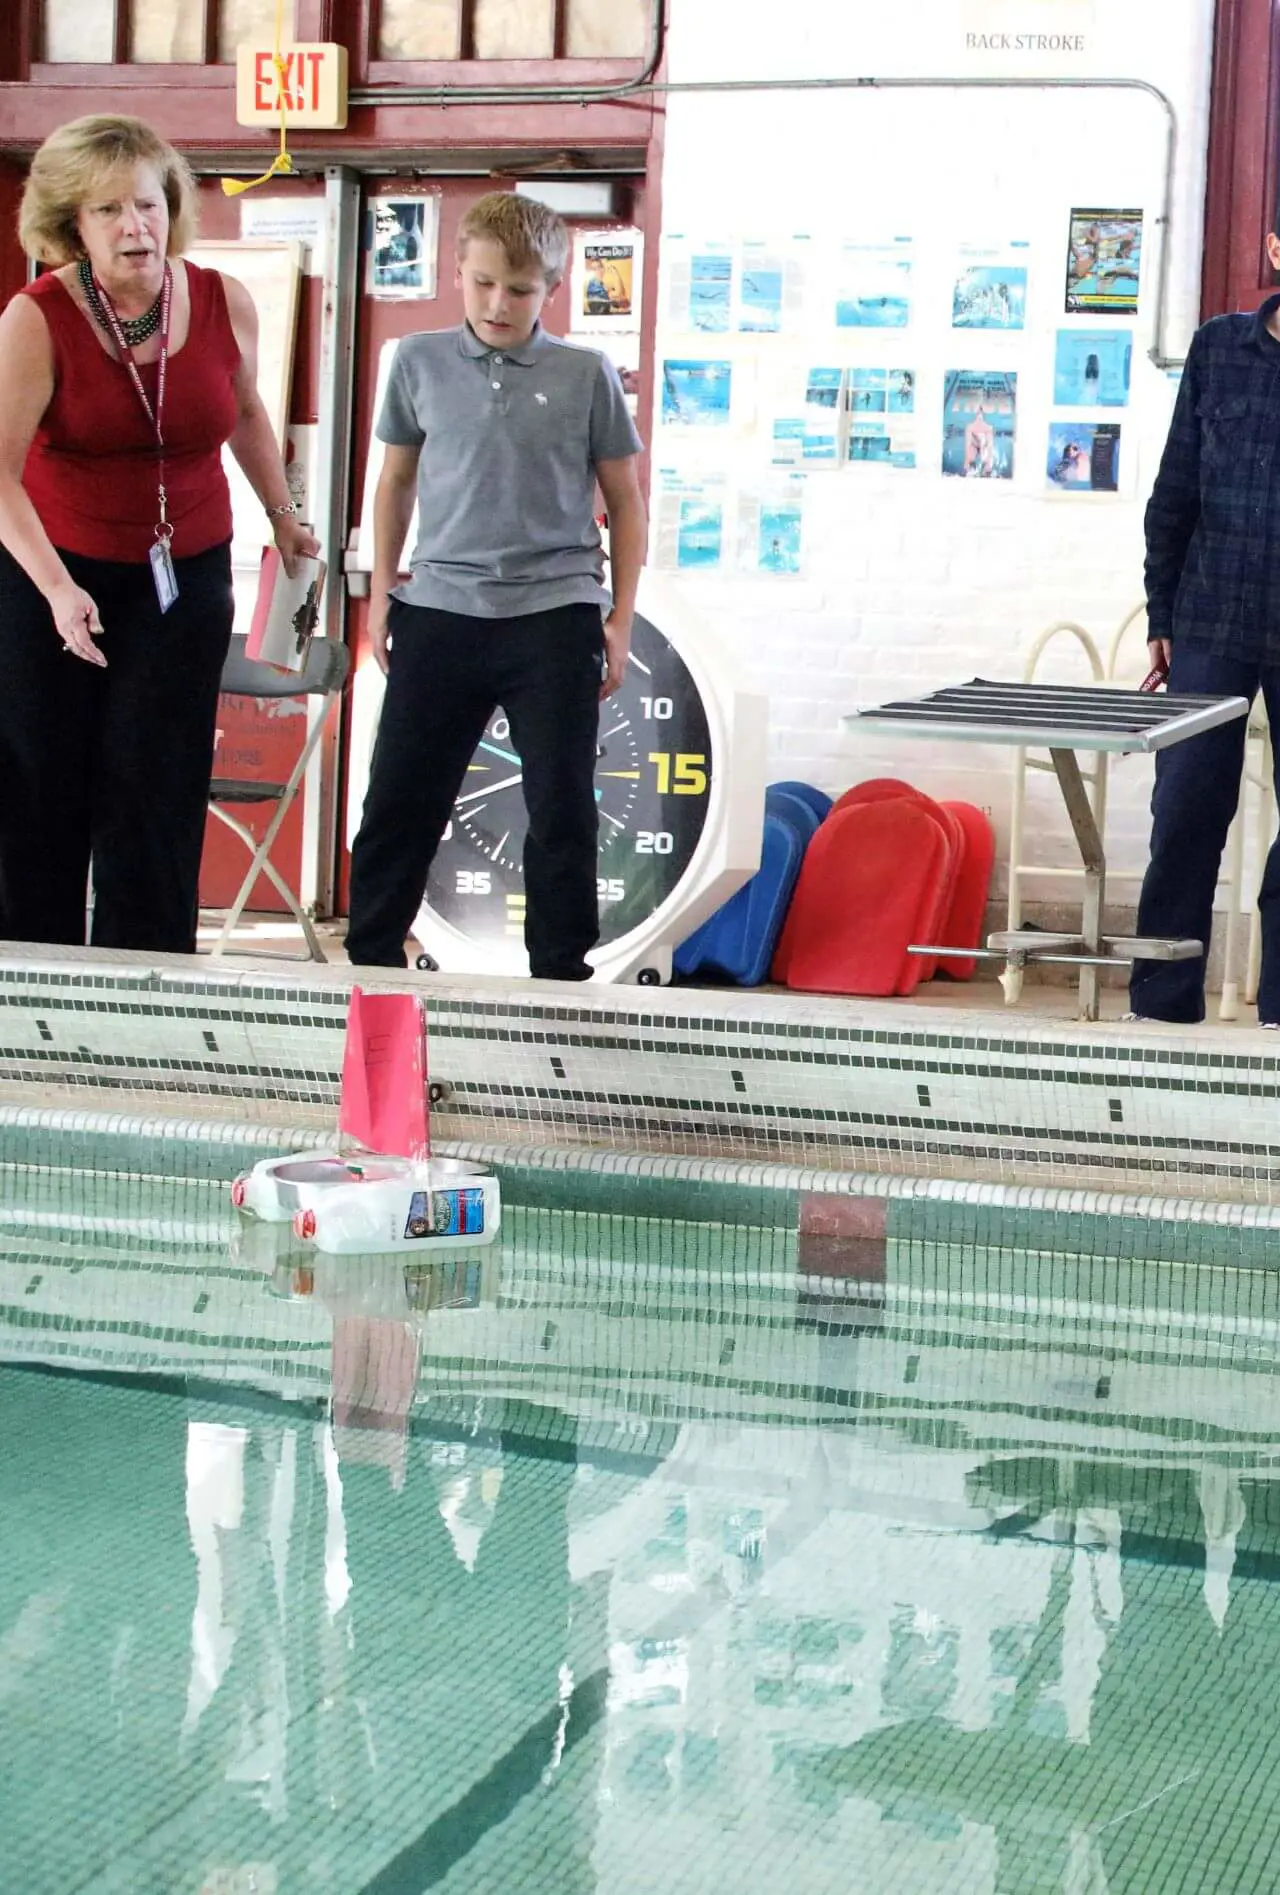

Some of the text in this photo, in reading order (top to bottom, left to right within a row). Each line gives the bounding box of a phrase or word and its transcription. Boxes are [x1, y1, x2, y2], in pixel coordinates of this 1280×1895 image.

[966, 32, 1085, 51] BACK STROKE
[256, 52, 325, 111] EXIT
[640, 697, 673, 720] 10
[648, 753, 707, 796] 15
[635, 831, 673, 854] 20
[456, 870, 492, 895] 35
